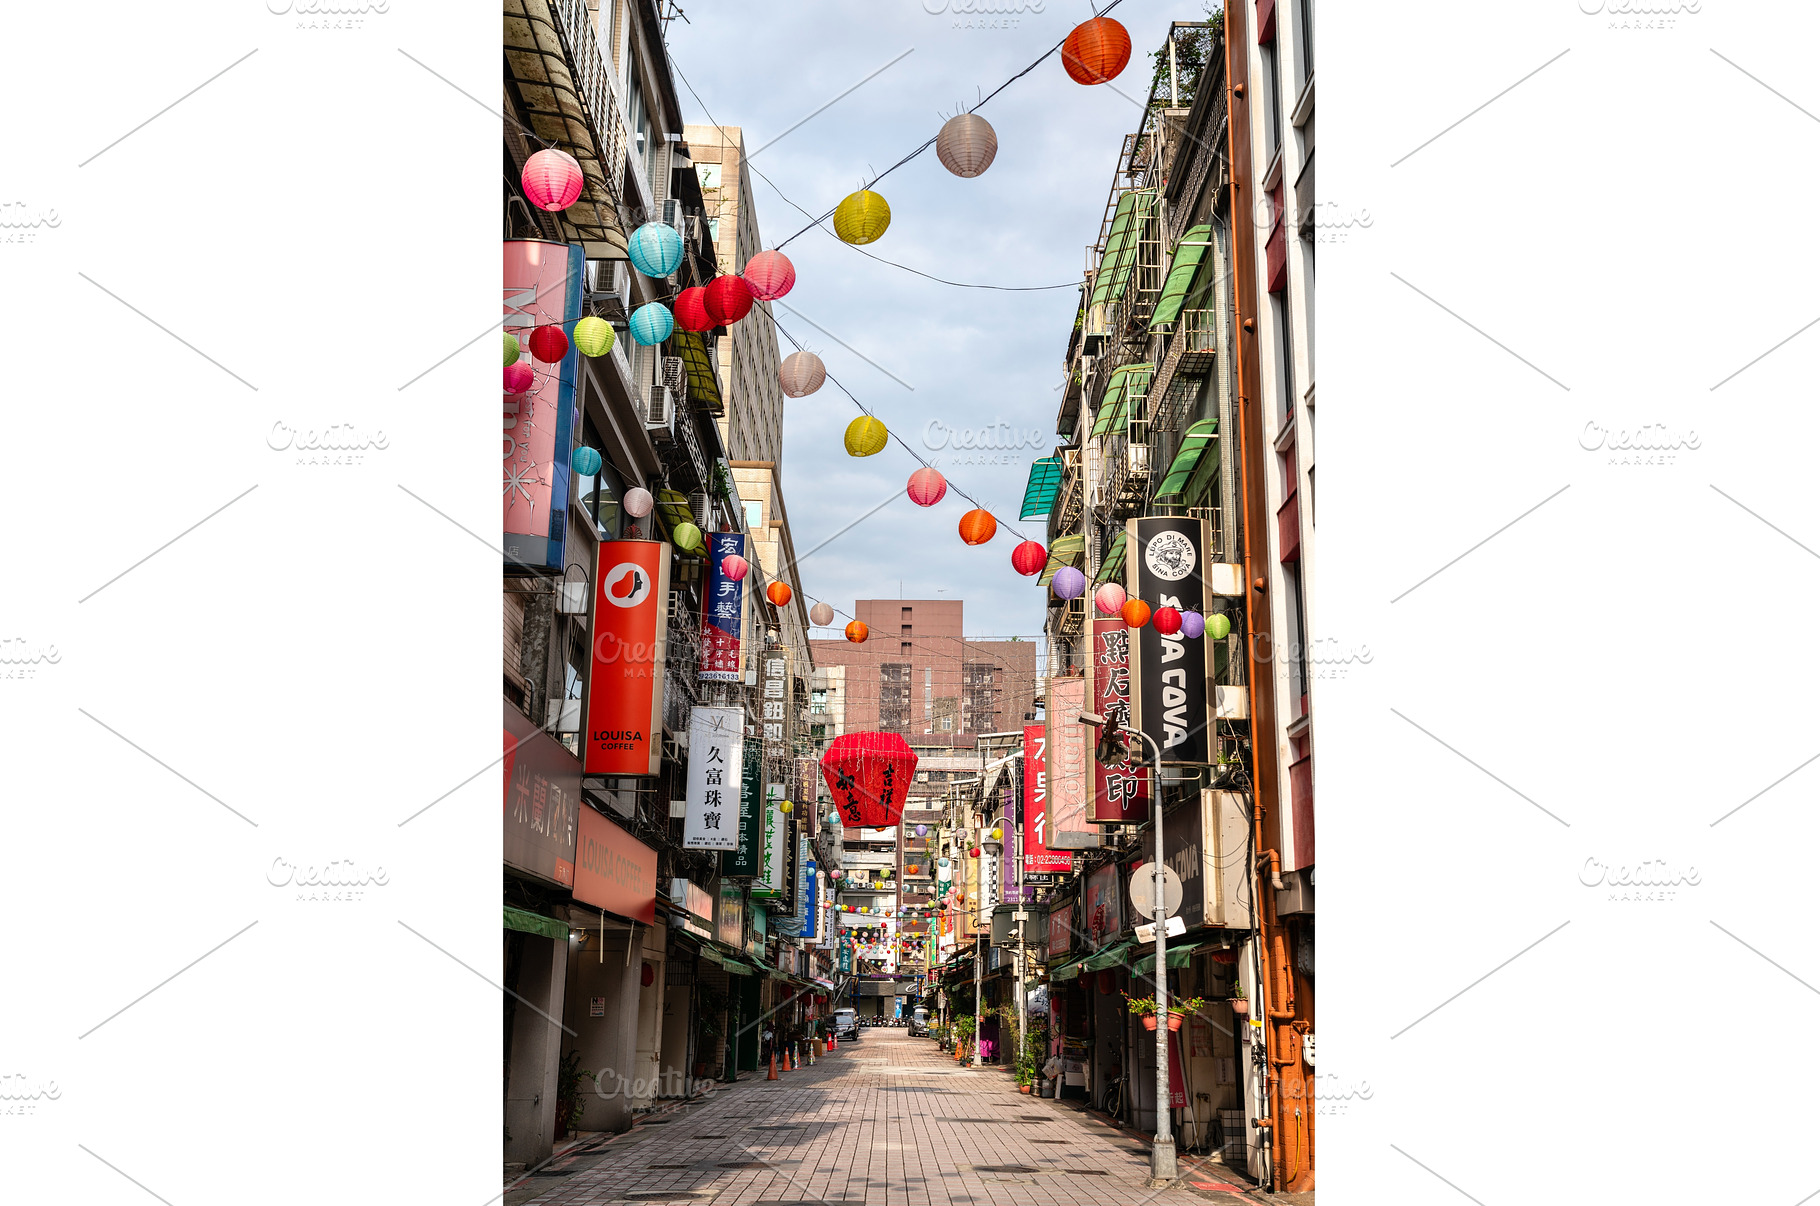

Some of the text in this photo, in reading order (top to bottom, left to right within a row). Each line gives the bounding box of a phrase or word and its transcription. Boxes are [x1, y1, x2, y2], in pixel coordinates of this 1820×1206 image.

[1149, 537, 1163, 556] LUPO
[1177, 537, 1193, 557] MARE
[714, 537, 739, 620] 宏手藝
[1171, 563, 1191, 577] COVA
[1162, 668, 1188, 749] COVA
[593, 730, 643, 742] LOUISA
[600, 743, 634, 751] COFFEE
[703, 746, 724, 831] 久富珠寶
[582, 835, 614, 881] LOUISA
[615, 853, 642, 895] COFFEE
